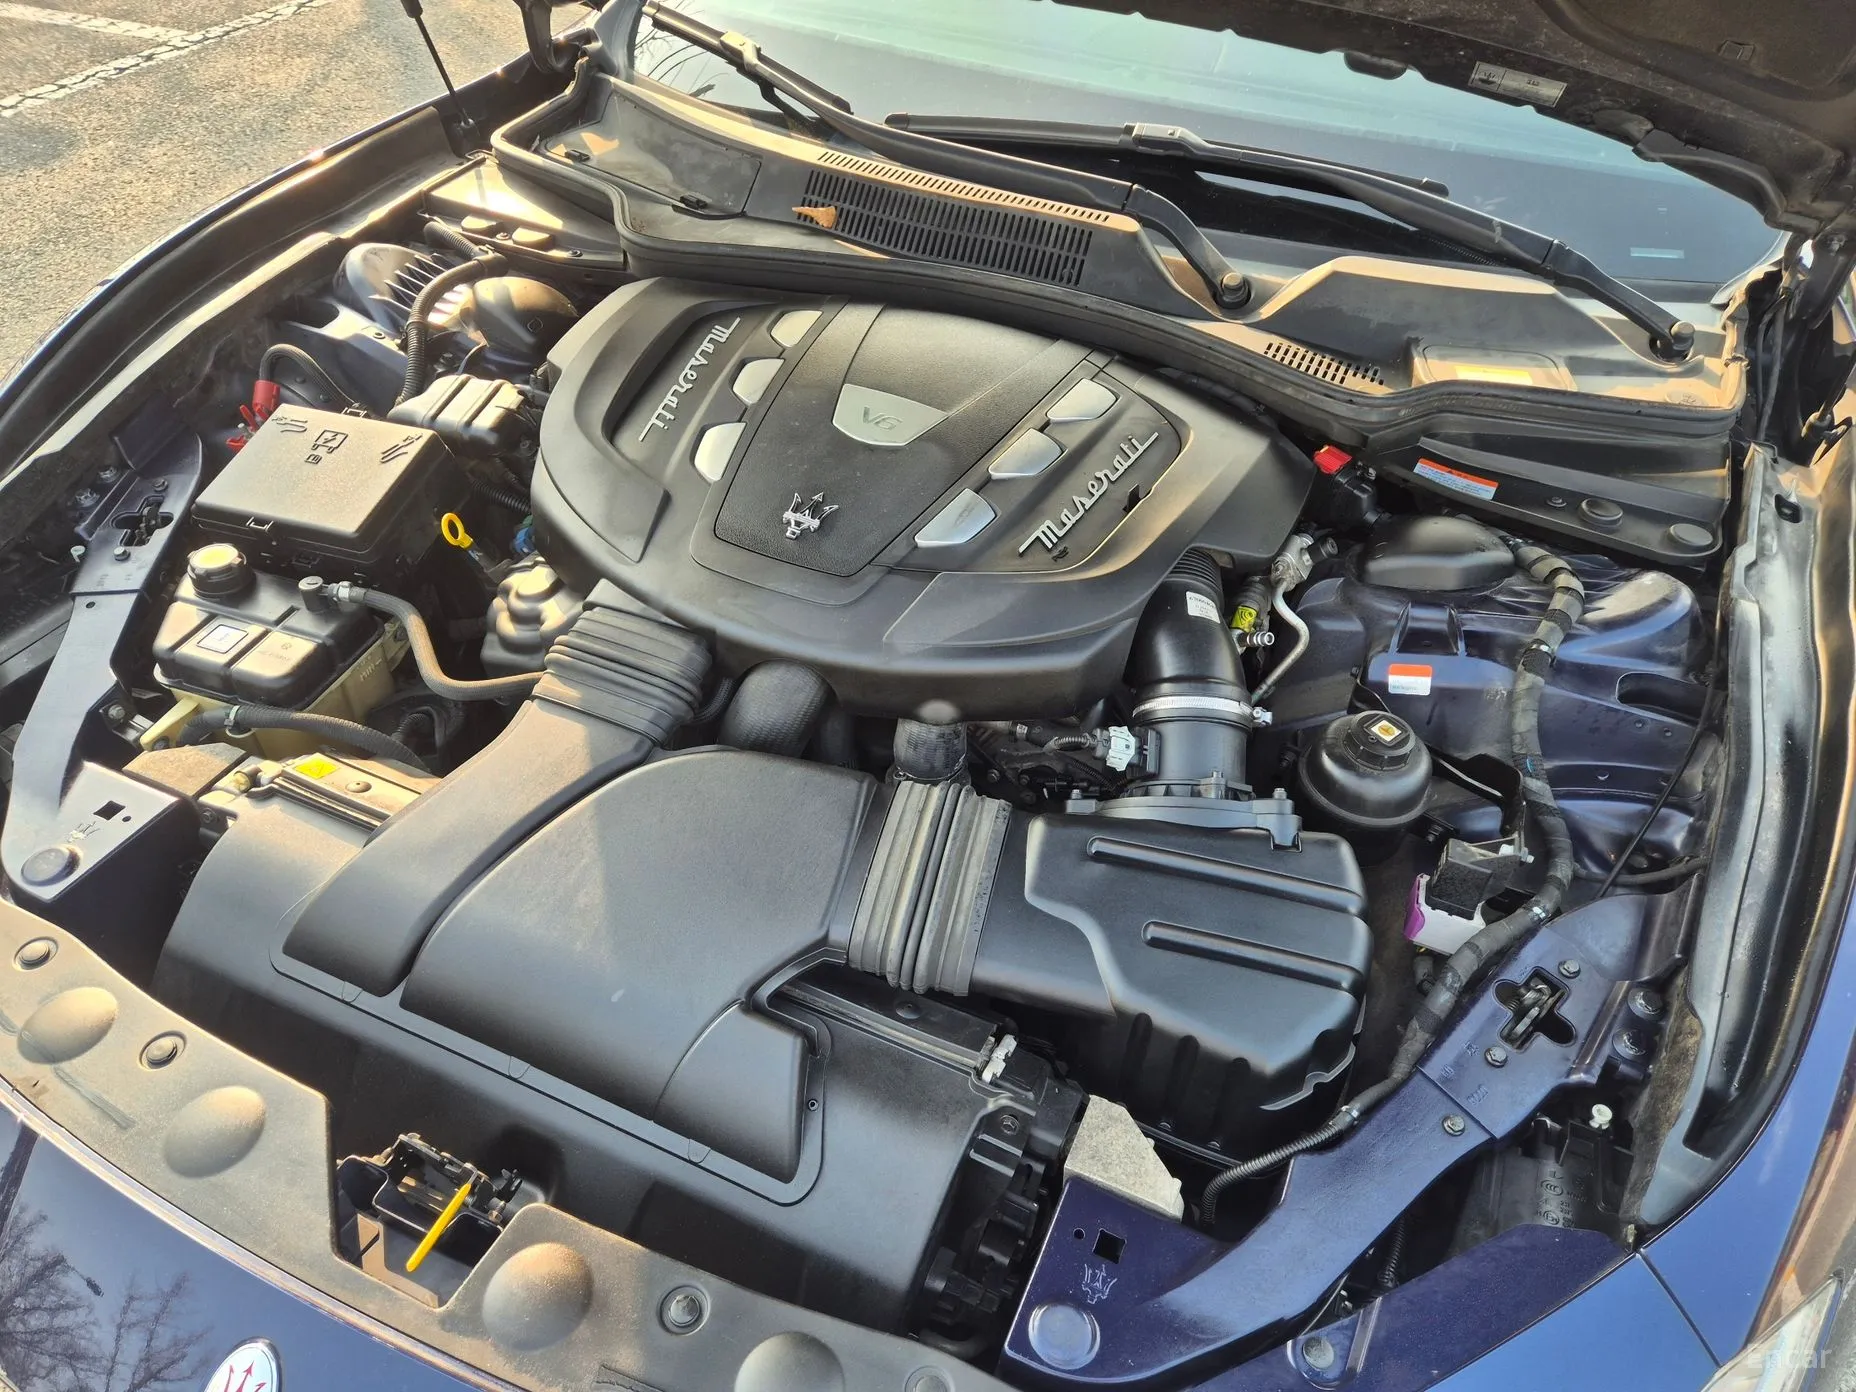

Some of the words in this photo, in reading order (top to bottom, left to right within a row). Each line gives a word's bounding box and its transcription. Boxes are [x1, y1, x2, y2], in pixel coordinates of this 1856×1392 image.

[639, 317, 741, 442] Maserati
[862, 405, 903, 431] V6
[1018, 431, 1159, 554] Maserati
